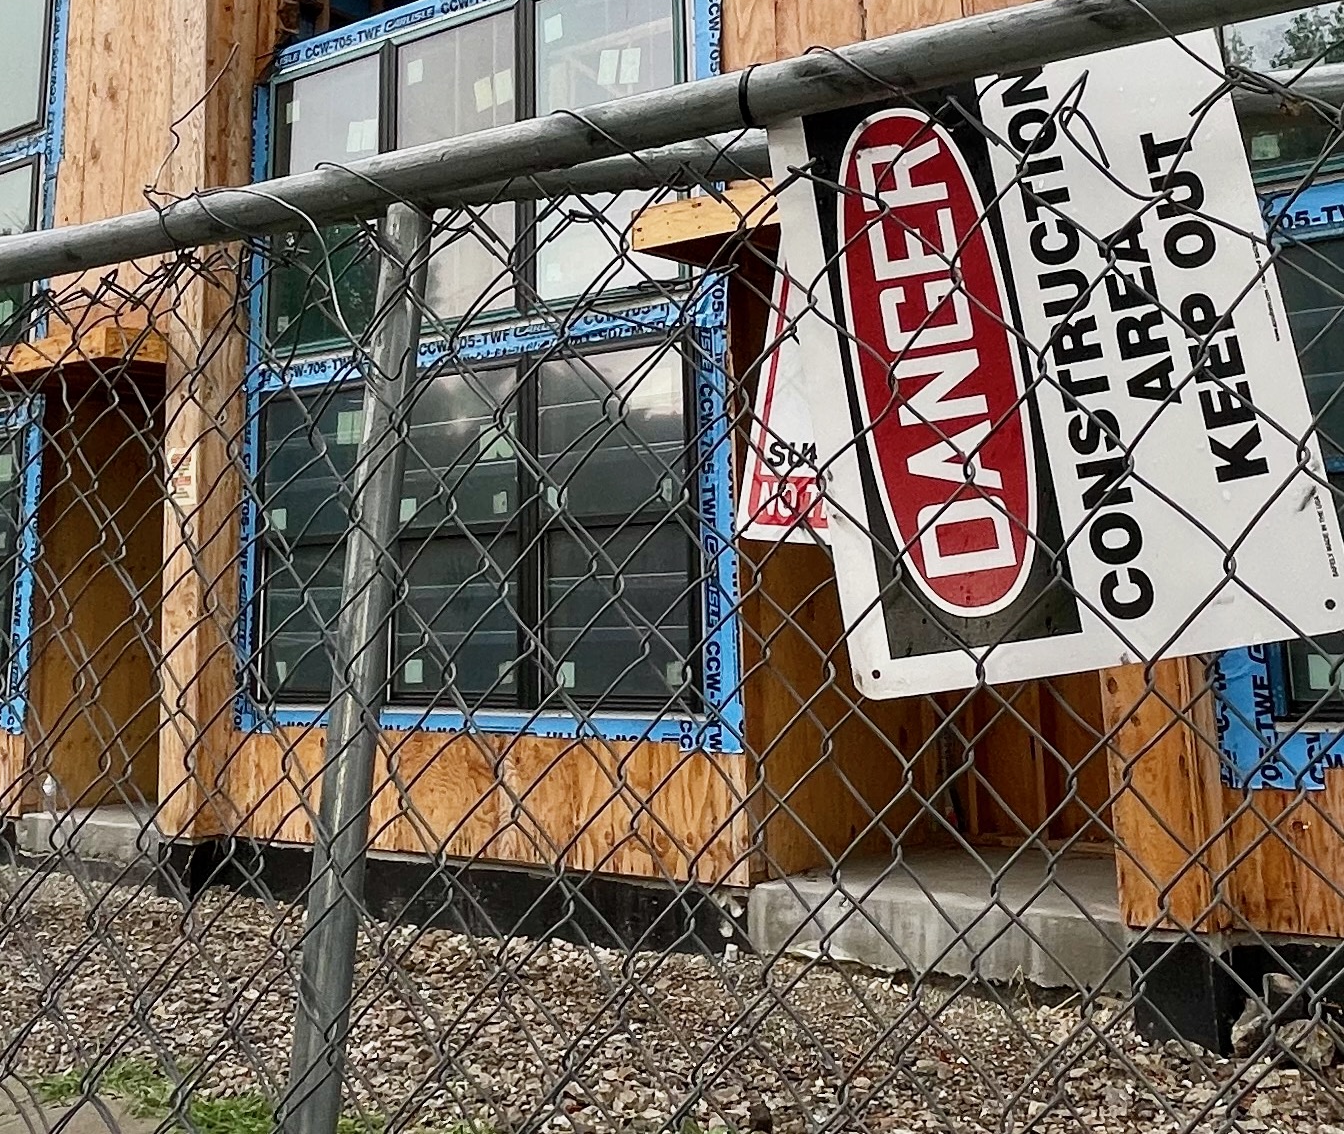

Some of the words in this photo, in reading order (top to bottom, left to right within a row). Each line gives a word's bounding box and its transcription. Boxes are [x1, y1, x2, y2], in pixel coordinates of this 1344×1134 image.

[305, 25, 382, 60] CCW-705-TWF
[1142, 132, 1218, 270] OUT
[855, 137, 1019, 580] DANGER
[998, 66, 1156, 621] CONSTRUCTION
[1102, 214, 1185, 405] AREA
[1181, 288, 1270, 485] KEEP
[1323, 532, 1333, 552] MADE
